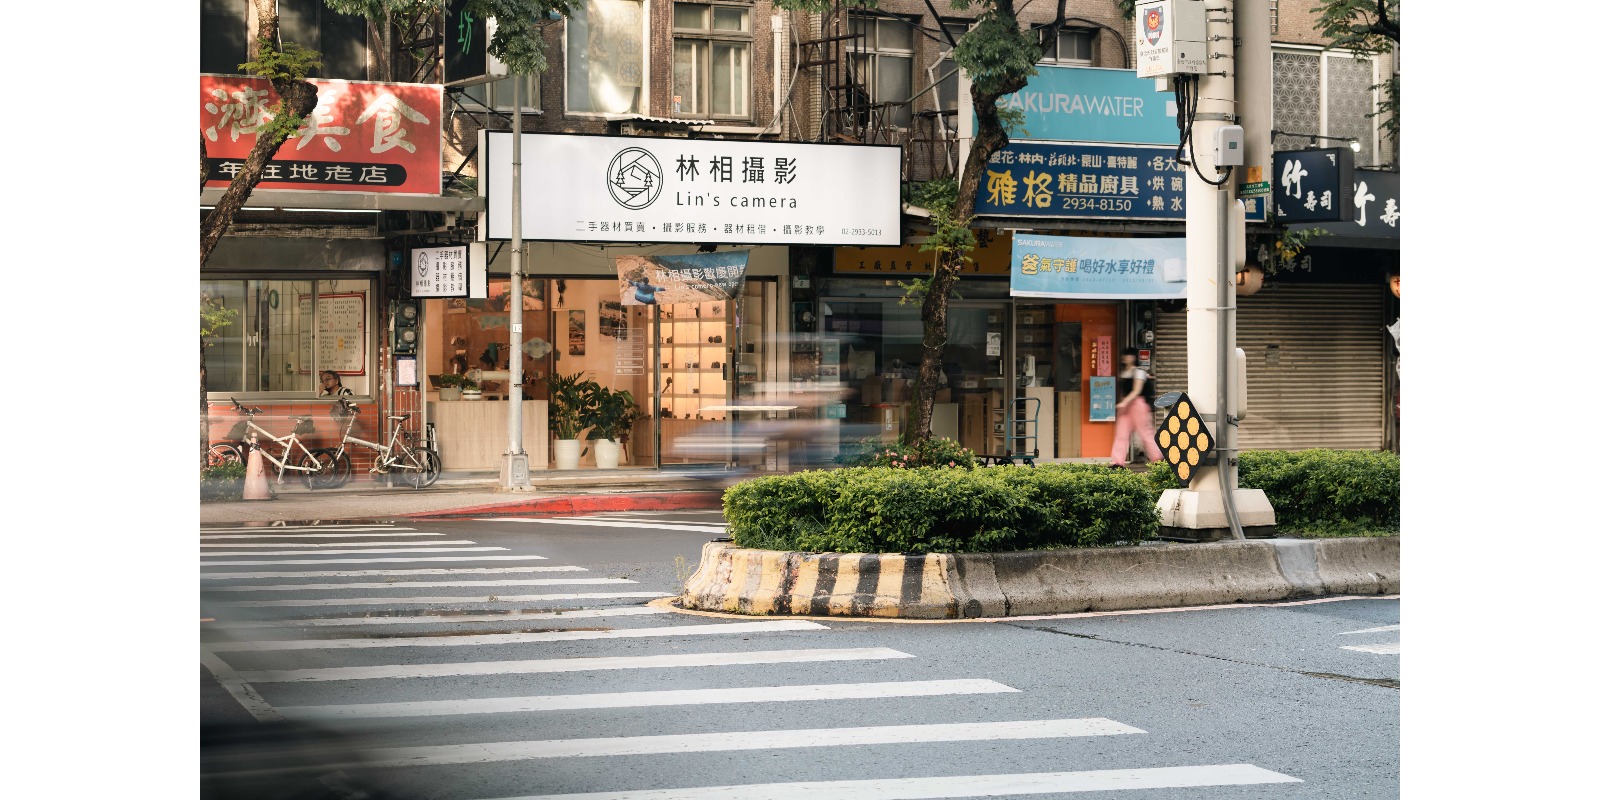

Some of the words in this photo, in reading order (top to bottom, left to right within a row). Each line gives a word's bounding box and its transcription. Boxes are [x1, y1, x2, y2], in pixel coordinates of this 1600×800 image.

[676, 153, 798, 186] 林相攝影
[676, 191, 721, 207] Lin's
[731, 193, 798, 210] camera
[986, 170, 1054, 208] 雅格
[1057, 173, 1140, 195] 精品廚具
[1062, 198, 1133, 212] 2934-8150
